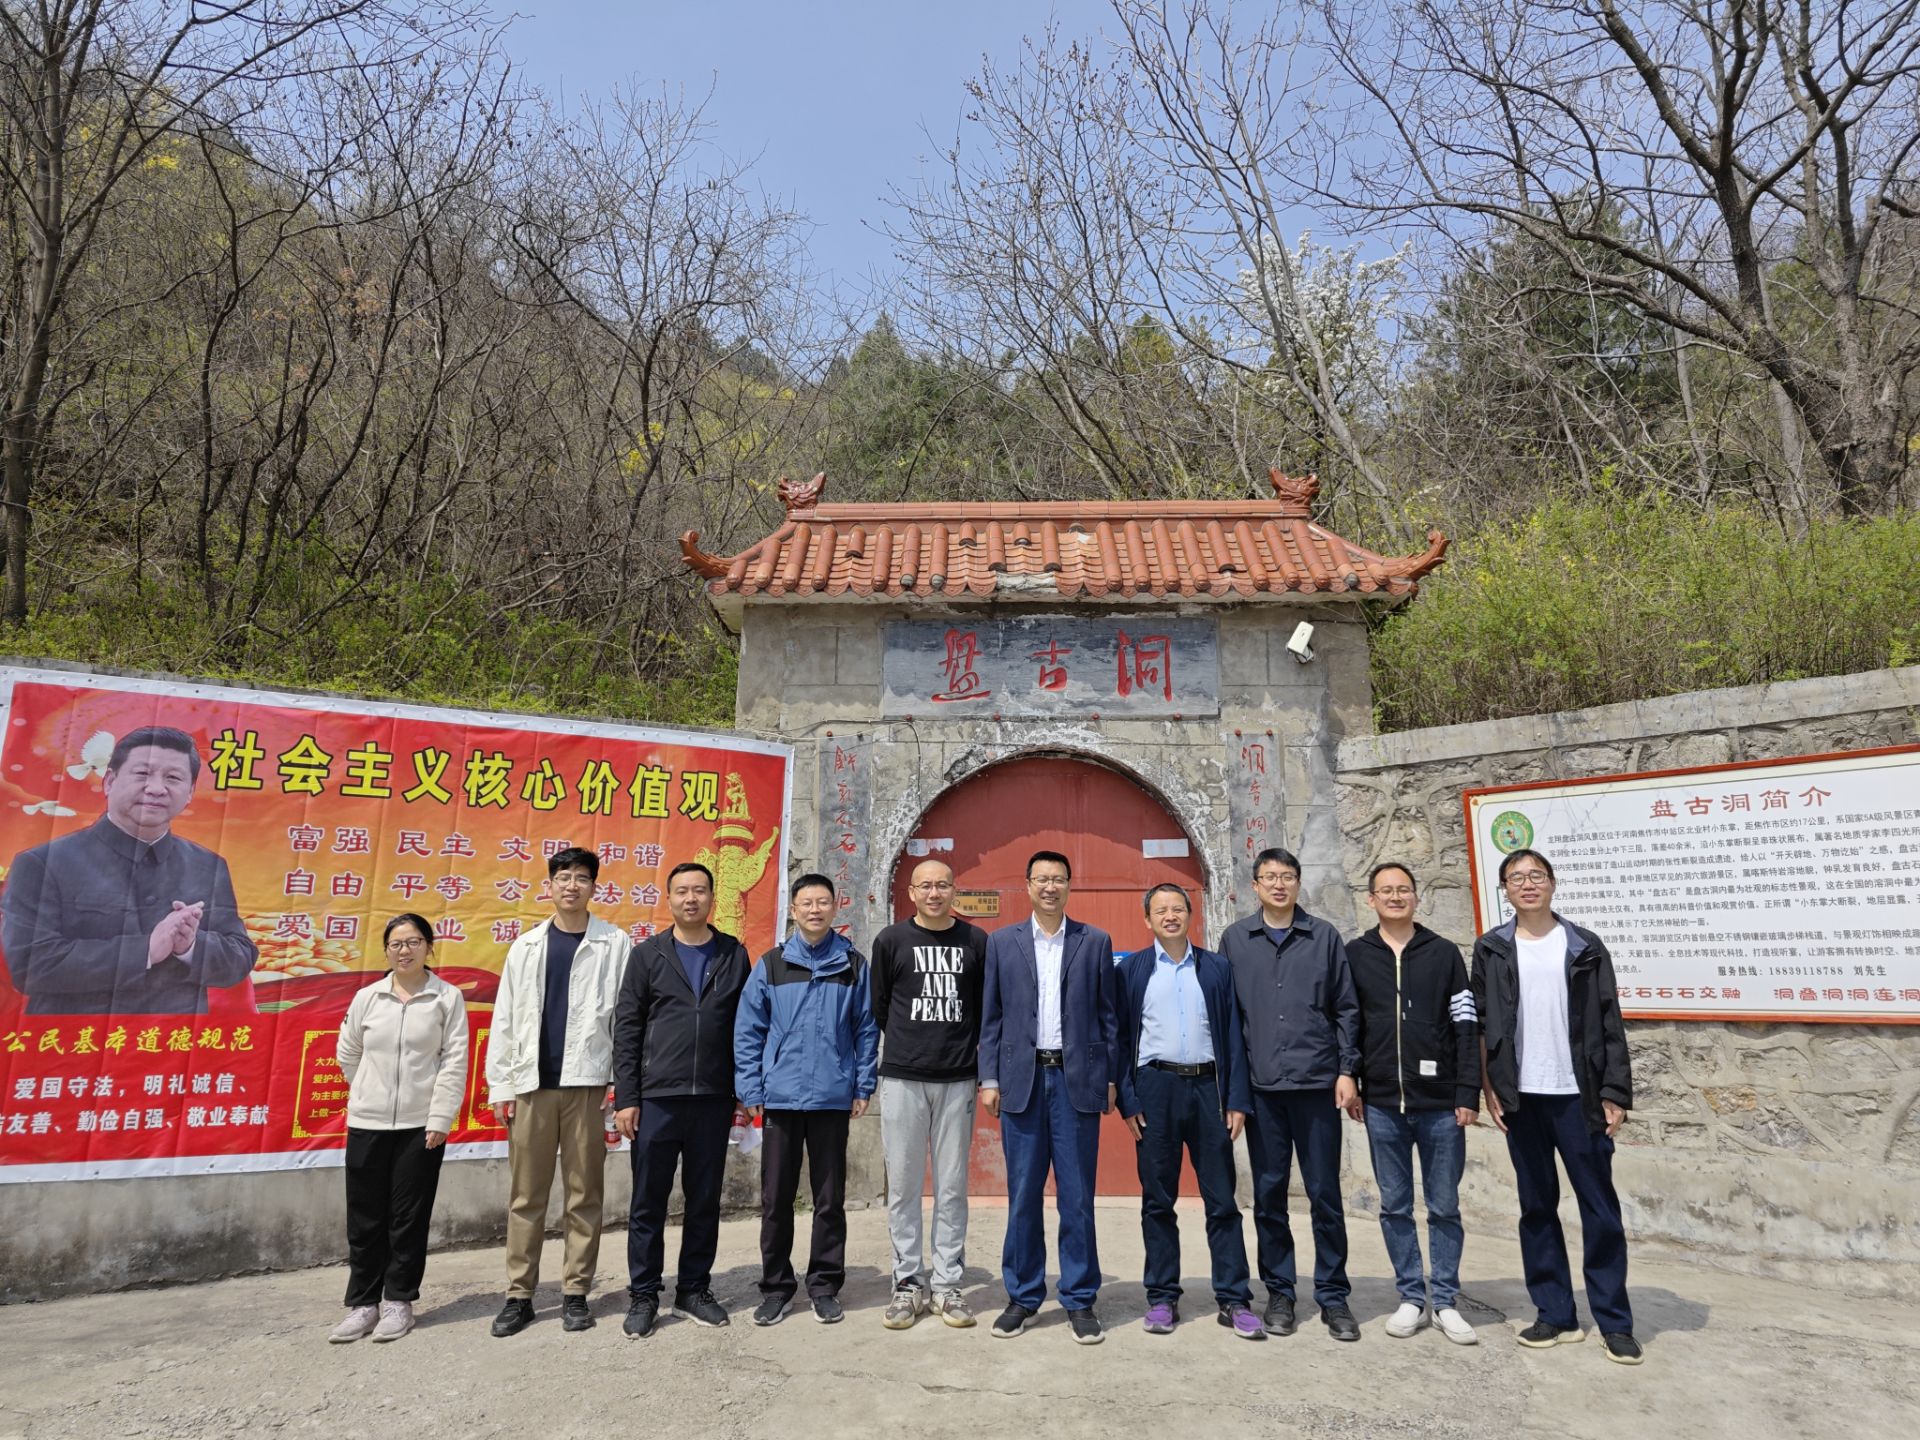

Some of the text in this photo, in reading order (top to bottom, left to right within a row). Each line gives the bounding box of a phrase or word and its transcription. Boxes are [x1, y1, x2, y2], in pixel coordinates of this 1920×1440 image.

[930, 629, 1171, 702] 盘古洞
[209, 728, 721, 822] 社会主义核心价值观
[1649, 785, 1832, 819] 盘古洞简介
[287, 824, 371, 854] 富强
[395, 830, 477, 858] 民主
[598, 842, 665, 868] 和谐
[283, 867, 365, 898] 自由
[390, 873, 472, 902] 平等
[592, 881, 662, 907] 法治
[272, 913, 362, 942] 爱国
[433, 918, 469, 942] 业
[630, 922, 657, 945] 善
[912, 946, 963, 973] NIKE
[1853, 964, 1888, 977] 刘先生
[920, 973, 958, 998] AND
[910, 998, 963, 1022] PEACE
[2, 1024, 255, 1056] 公民基本道德规范
[0, 1104, 270, 1135] 友善、勤俭自强、敬业奉献
